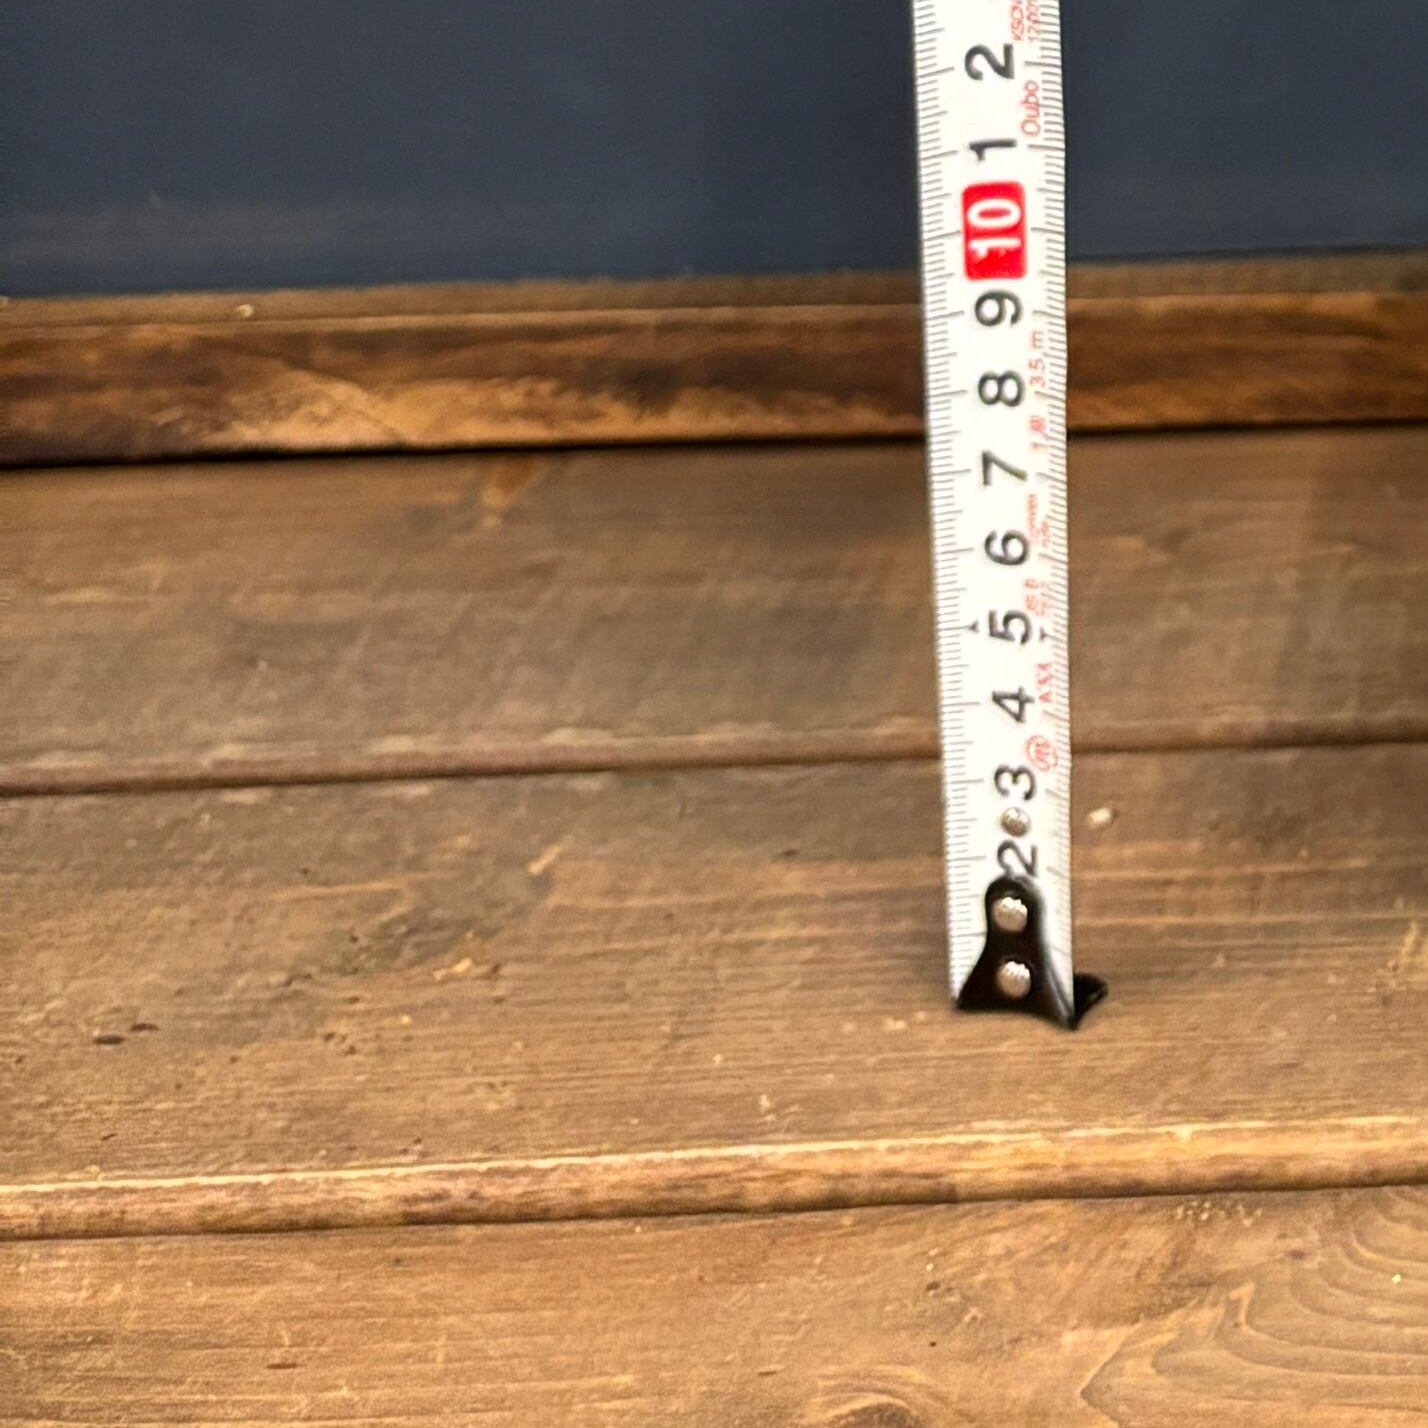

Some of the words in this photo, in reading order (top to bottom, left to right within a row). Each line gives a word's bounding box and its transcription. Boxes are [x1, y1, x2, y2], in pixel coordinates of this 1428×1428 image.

[964, 43, 1015, 81] 2
[968, 138, 1017, 162] 1
[967, 198, 1022, 259] 10
[974, 289, 1023, 328] 9
[977, 370, 1025, 408] 8
[981, 450, 1028, 487] 7
[984, 530, 1030, 567] 6
[988, 610, 1032, 646] 5
[992, 687, 1035, 724] 4
[994, 765, 1036, 801] 3
[997, 840, 1038, 879] 2
